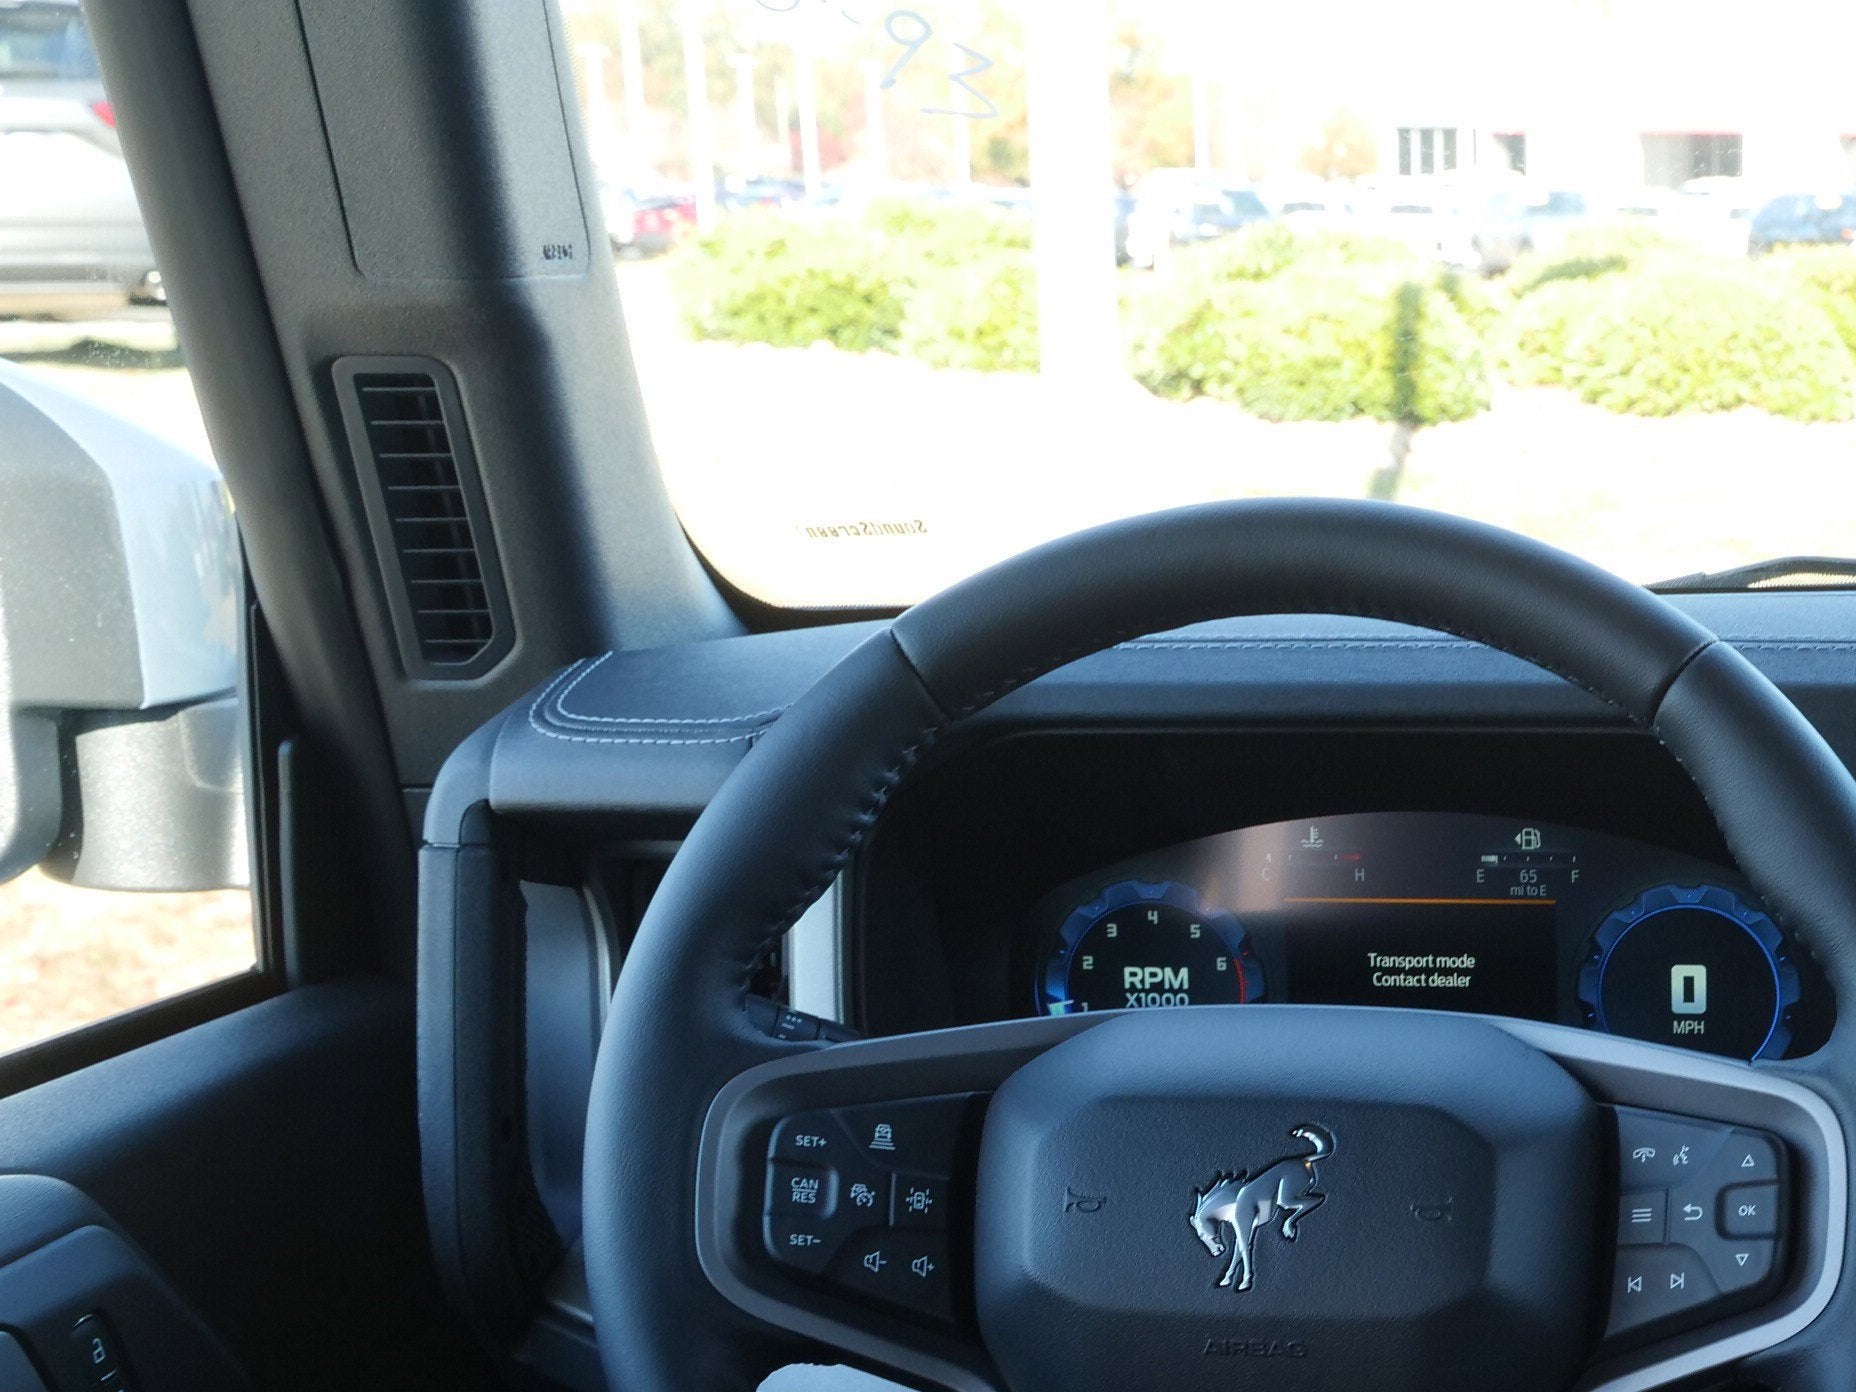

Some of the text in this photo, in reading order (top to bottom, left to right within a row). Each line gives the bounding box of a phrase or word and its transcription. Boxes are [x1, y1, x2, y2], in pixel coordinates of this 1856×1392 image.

[1354, 867, 1365, 881] H
[1476, 869, 1485, 883] E
[1519, 869, 1538, 883] 65
[1571, 869, 1580, 883] F
[1510, 884, 1547, 896] mi to E
[1147, 910, 1158, 925] 4
[1106, 923, 1118, 938] 3
[1190, 924, 1201, 939] 5
[1082, 955, 1094, 970] 2
[1216, 956, 1228, 971] 6
[1367, 952, 1476, 970] Transport mode
[1123, 966, 1189, 990] RPM
[1372, 972, 1472, 988] Contact dealer
[1671, 964, 1707, 1014] 0
[1125, 992, 1189, 1008] X1000
[1672, 1020, 1705, 1035] MPH
[791, 1177, 819, 1190] CAN
[792, 1192, 816, 1204] RES
[1738, 1204, 1756, 1217] OK
[1202, 1337, 1309, 1359] AIRBAG
